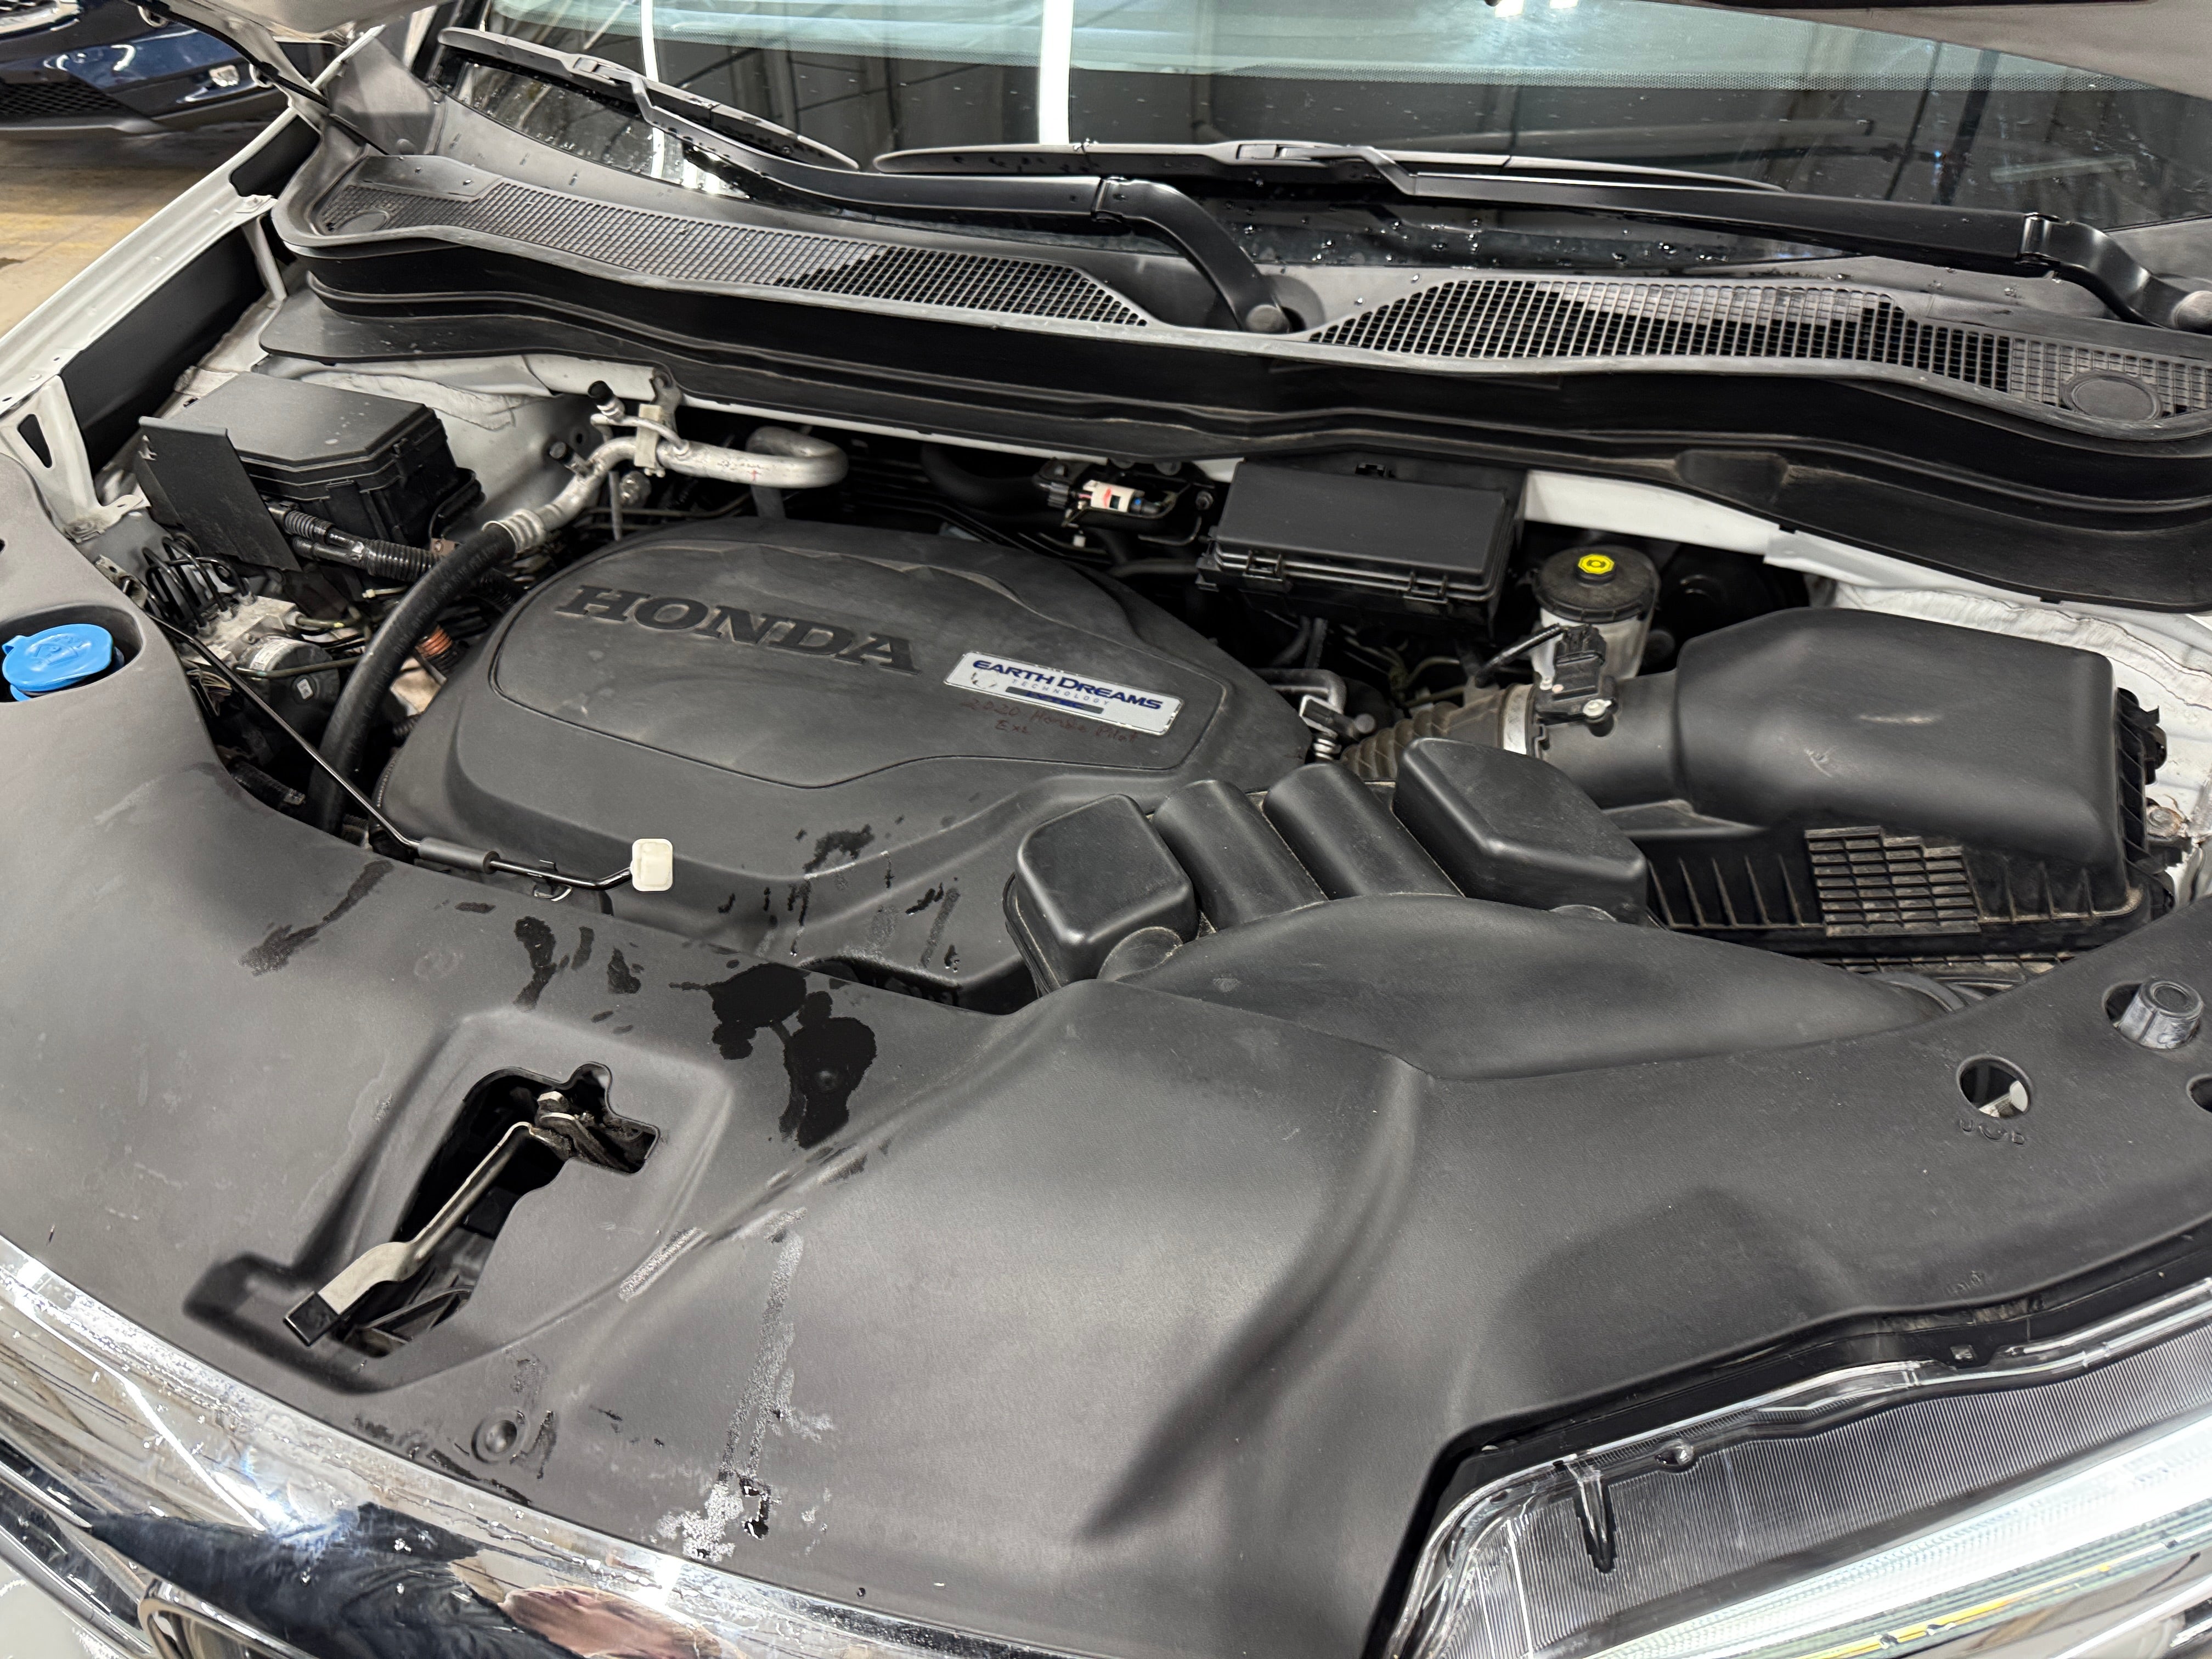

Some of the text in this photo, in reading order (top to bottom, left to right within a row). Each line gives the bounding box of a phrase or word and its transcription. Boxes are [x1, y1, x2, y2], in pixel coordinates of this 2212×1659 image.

[554, 584, 922, 675] HONDA
[973, 659, 1164, 710] EARTH DREAMS
[1011, 678, 1110, 706] TECHNOLOGY
[961, 697, 1021, 716] 2020
